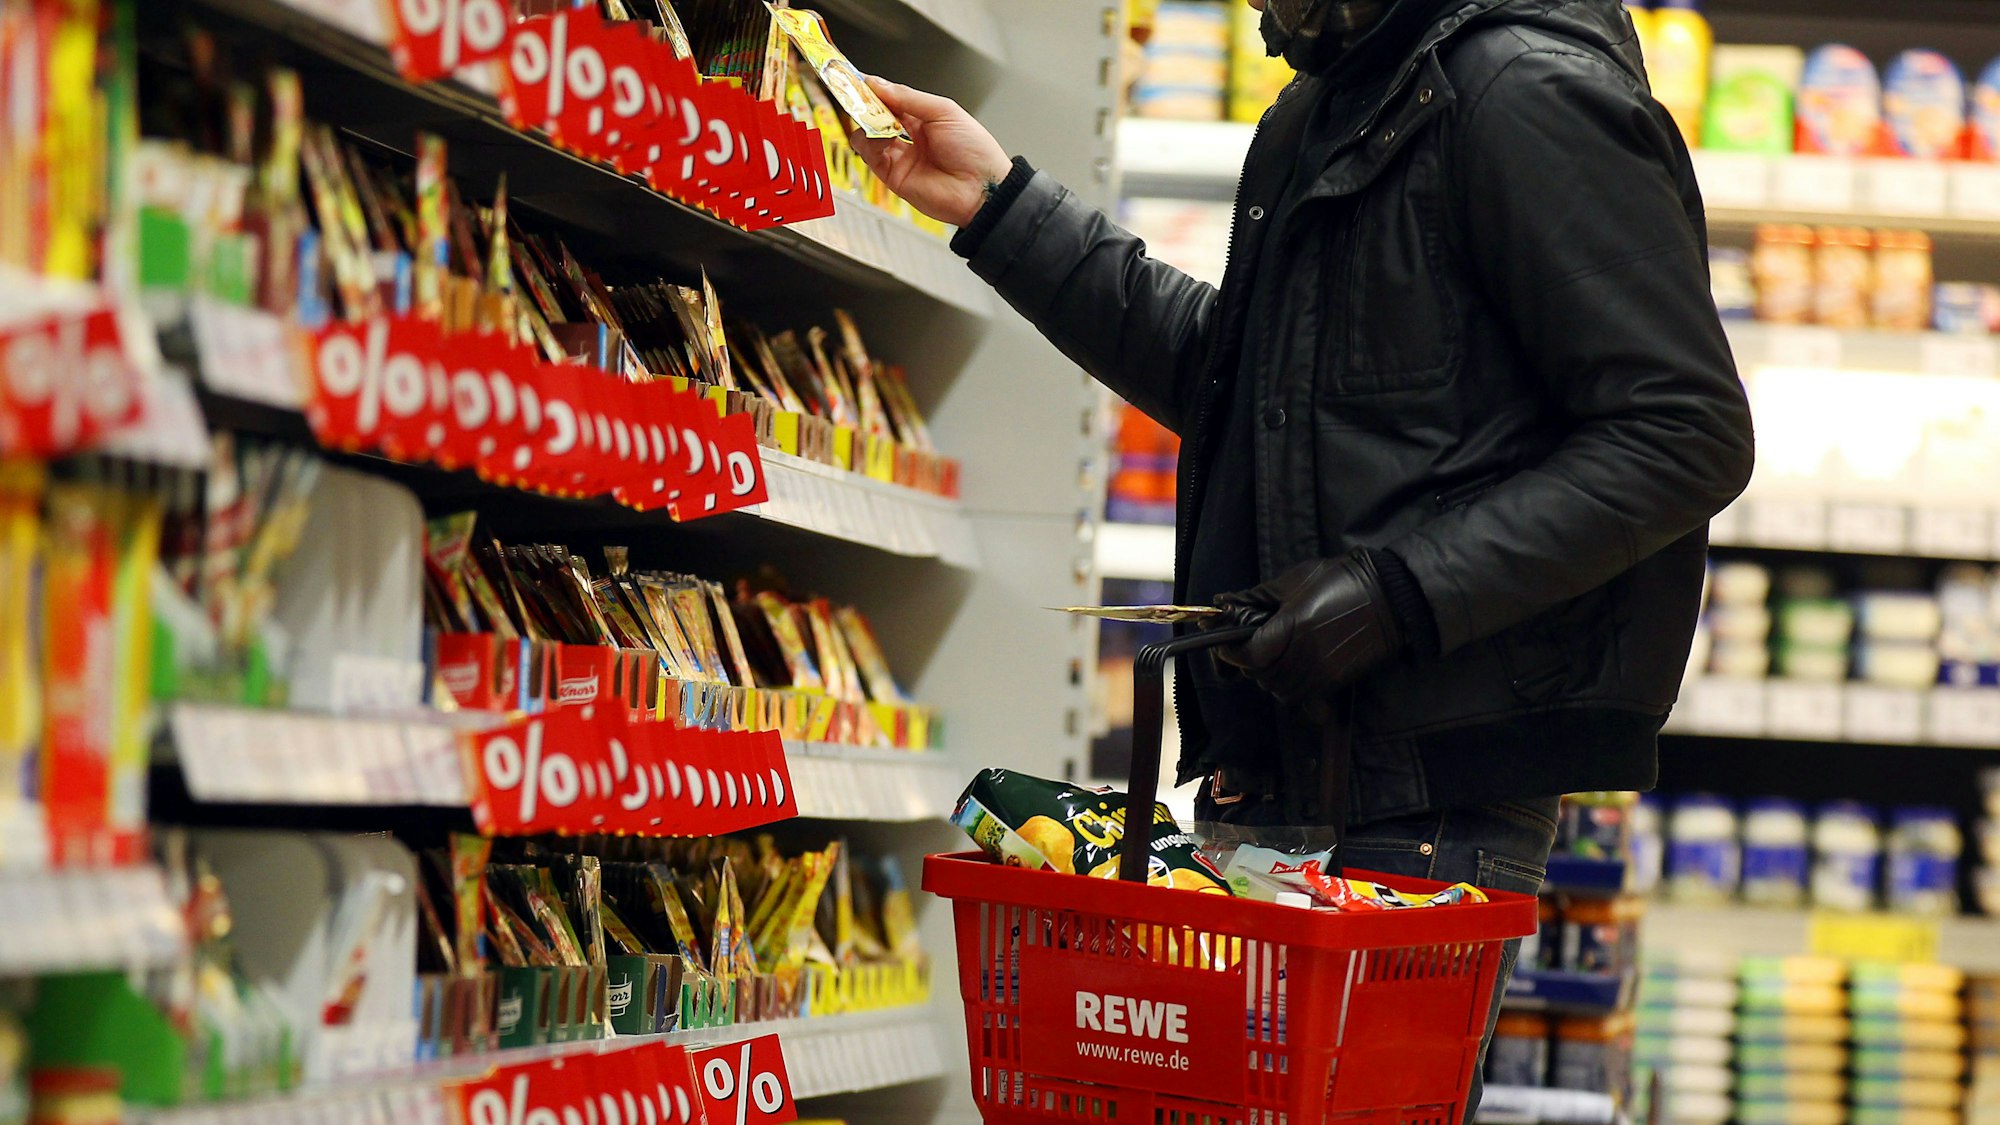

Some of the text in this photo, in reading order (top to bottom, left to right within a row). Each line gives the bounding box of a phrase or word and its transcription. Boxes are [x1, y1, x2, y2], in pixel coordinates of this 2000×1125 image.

[401, 0, 505, 71] %
[510, 13, 607, 118] %
[319, 318, 427, 434] %
[483, 719, 580, 824] %
[1076, 990, 1189, 1044] REWE
[1076, 1041, 1189, 1071] www.rewe.de
[703, 1043, 784, 1125] %
